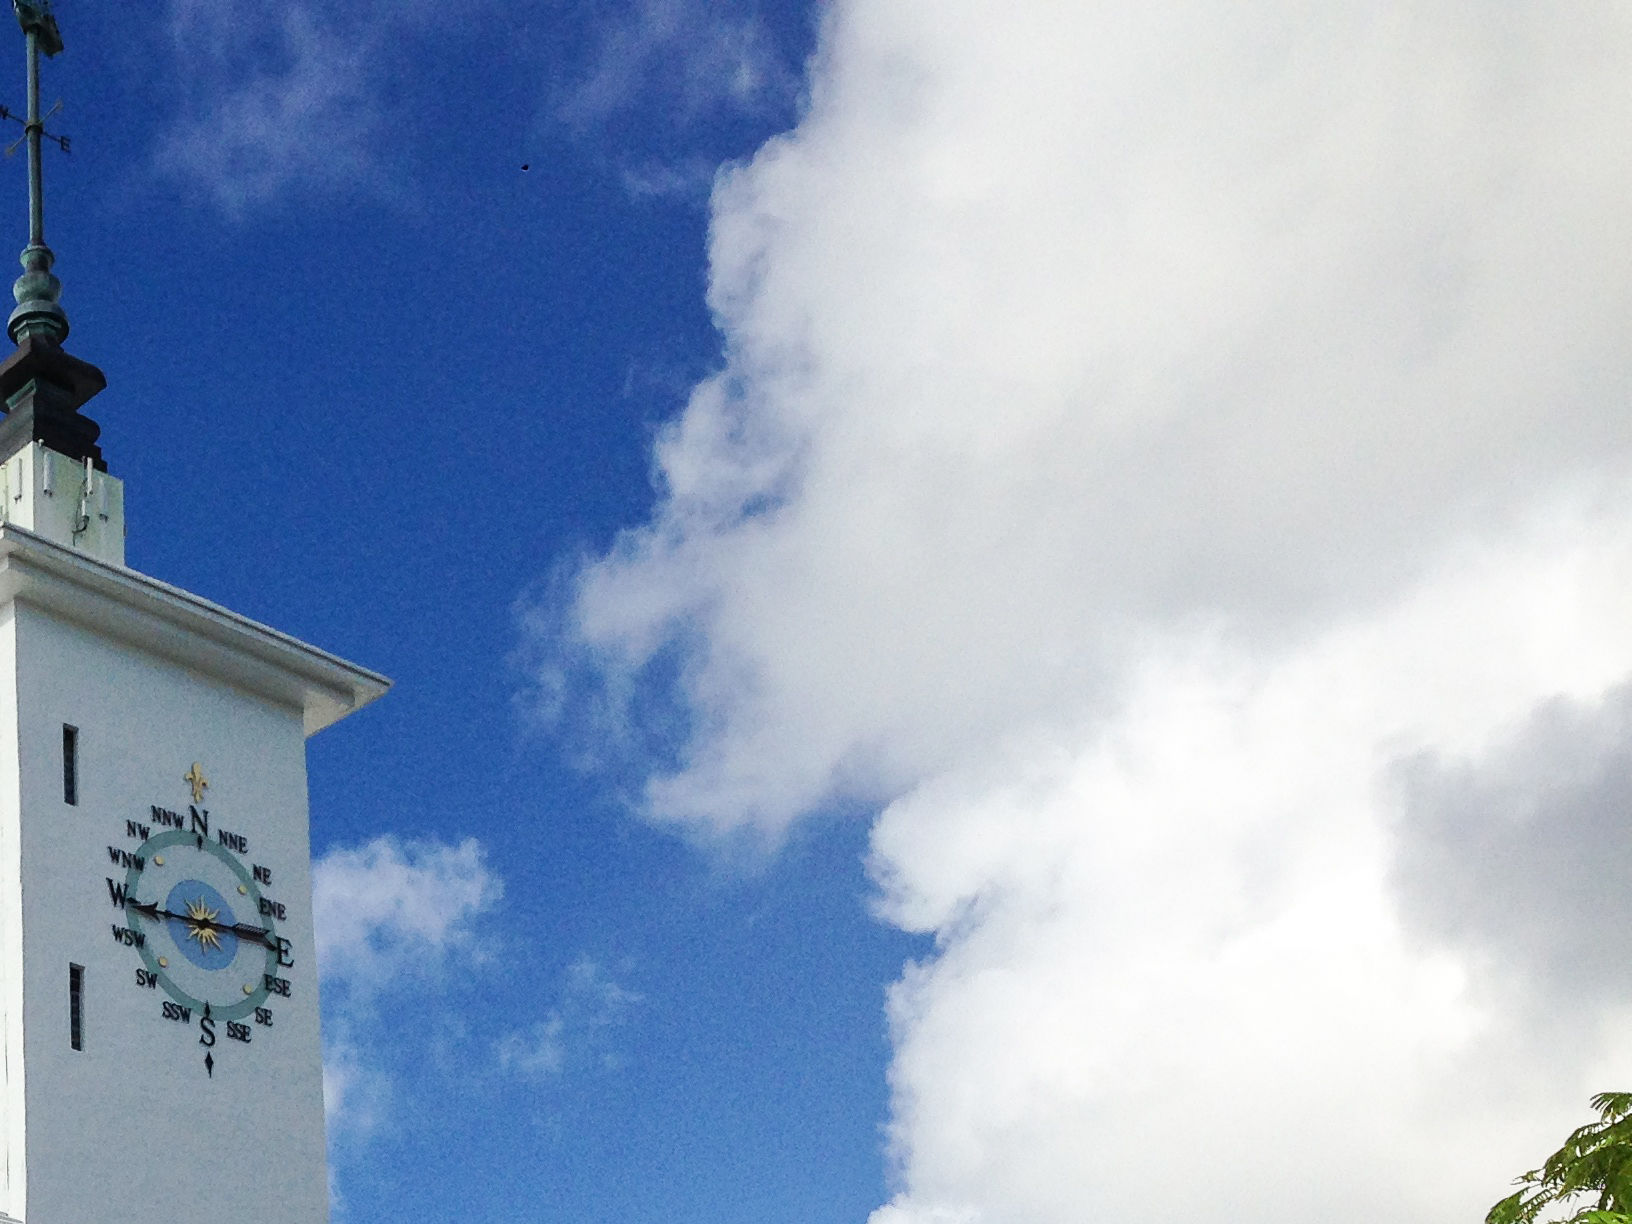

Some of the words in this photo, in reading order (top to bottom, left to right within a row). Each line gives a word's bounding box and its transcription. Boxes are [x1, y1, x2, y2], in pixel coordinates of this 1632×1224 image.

[61, 135, 71, 153] E
[151, 805, 184, 830] NNW
[189, 805, 208, 837] N
[126, 819, 150, 841] NW
[218, 829, 248, 854] NNE
[107, 846, 145, 872] WNW
[253, 863, 272, 886] NE
[106, 877, 128, 910] W
[259, 897, 286, 921] ENE
[112, 924, 145, 949] WSW
[276, 936, 294, 968] E
[136, 968, 158, 989] SW
[264, 974, 292, 998] ESE
[162, 1001, 191, 1024] SSW
[255, 1006, 273, 1027] SE
[199, 1016, 216, 1047] S
[227, 1021, 251, 1043] SSE
